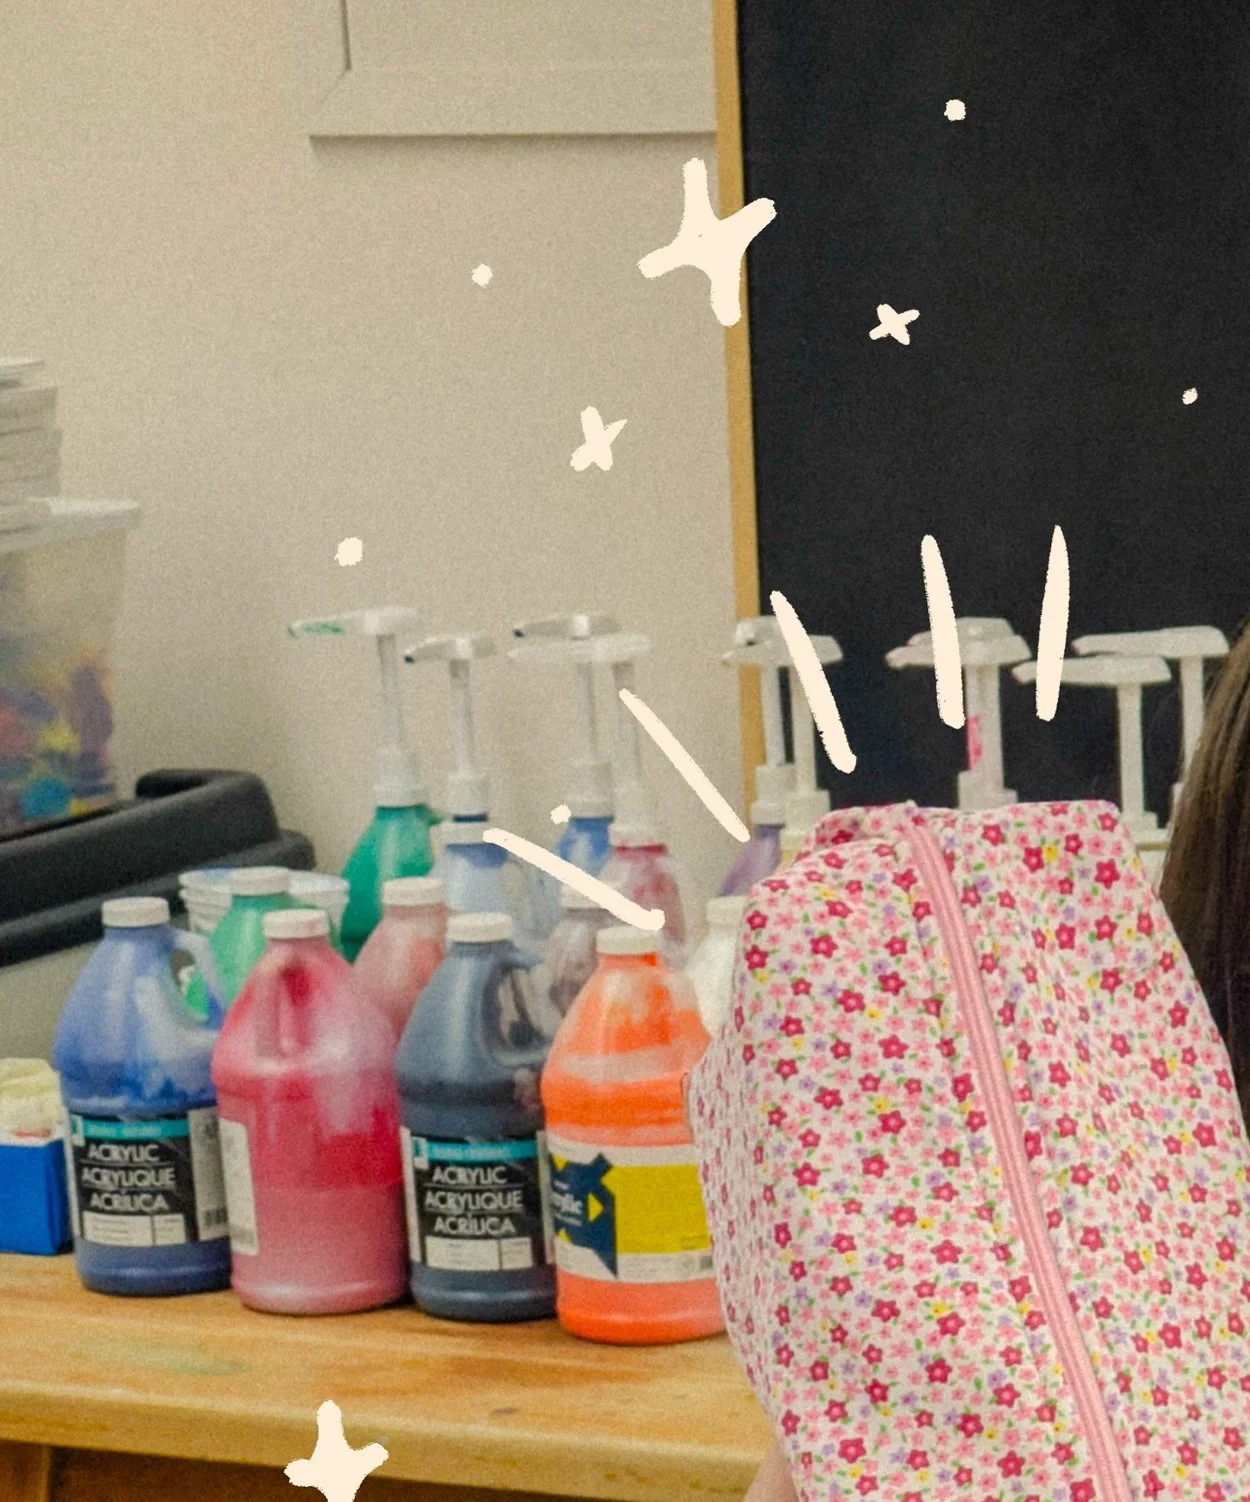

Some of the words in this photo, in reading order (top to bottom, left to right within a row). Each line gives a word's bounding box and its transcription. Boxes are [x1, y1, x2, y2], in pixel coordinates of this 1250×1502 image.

[88, 1143, 161, 1162] ACRYLIC
[81, 1166, 177, 1188] ACRYLIQUE
[431, 1165, 508, 1184] ACRYLIC
[424, 1189, 524, 1211] ACRYLIQUE
